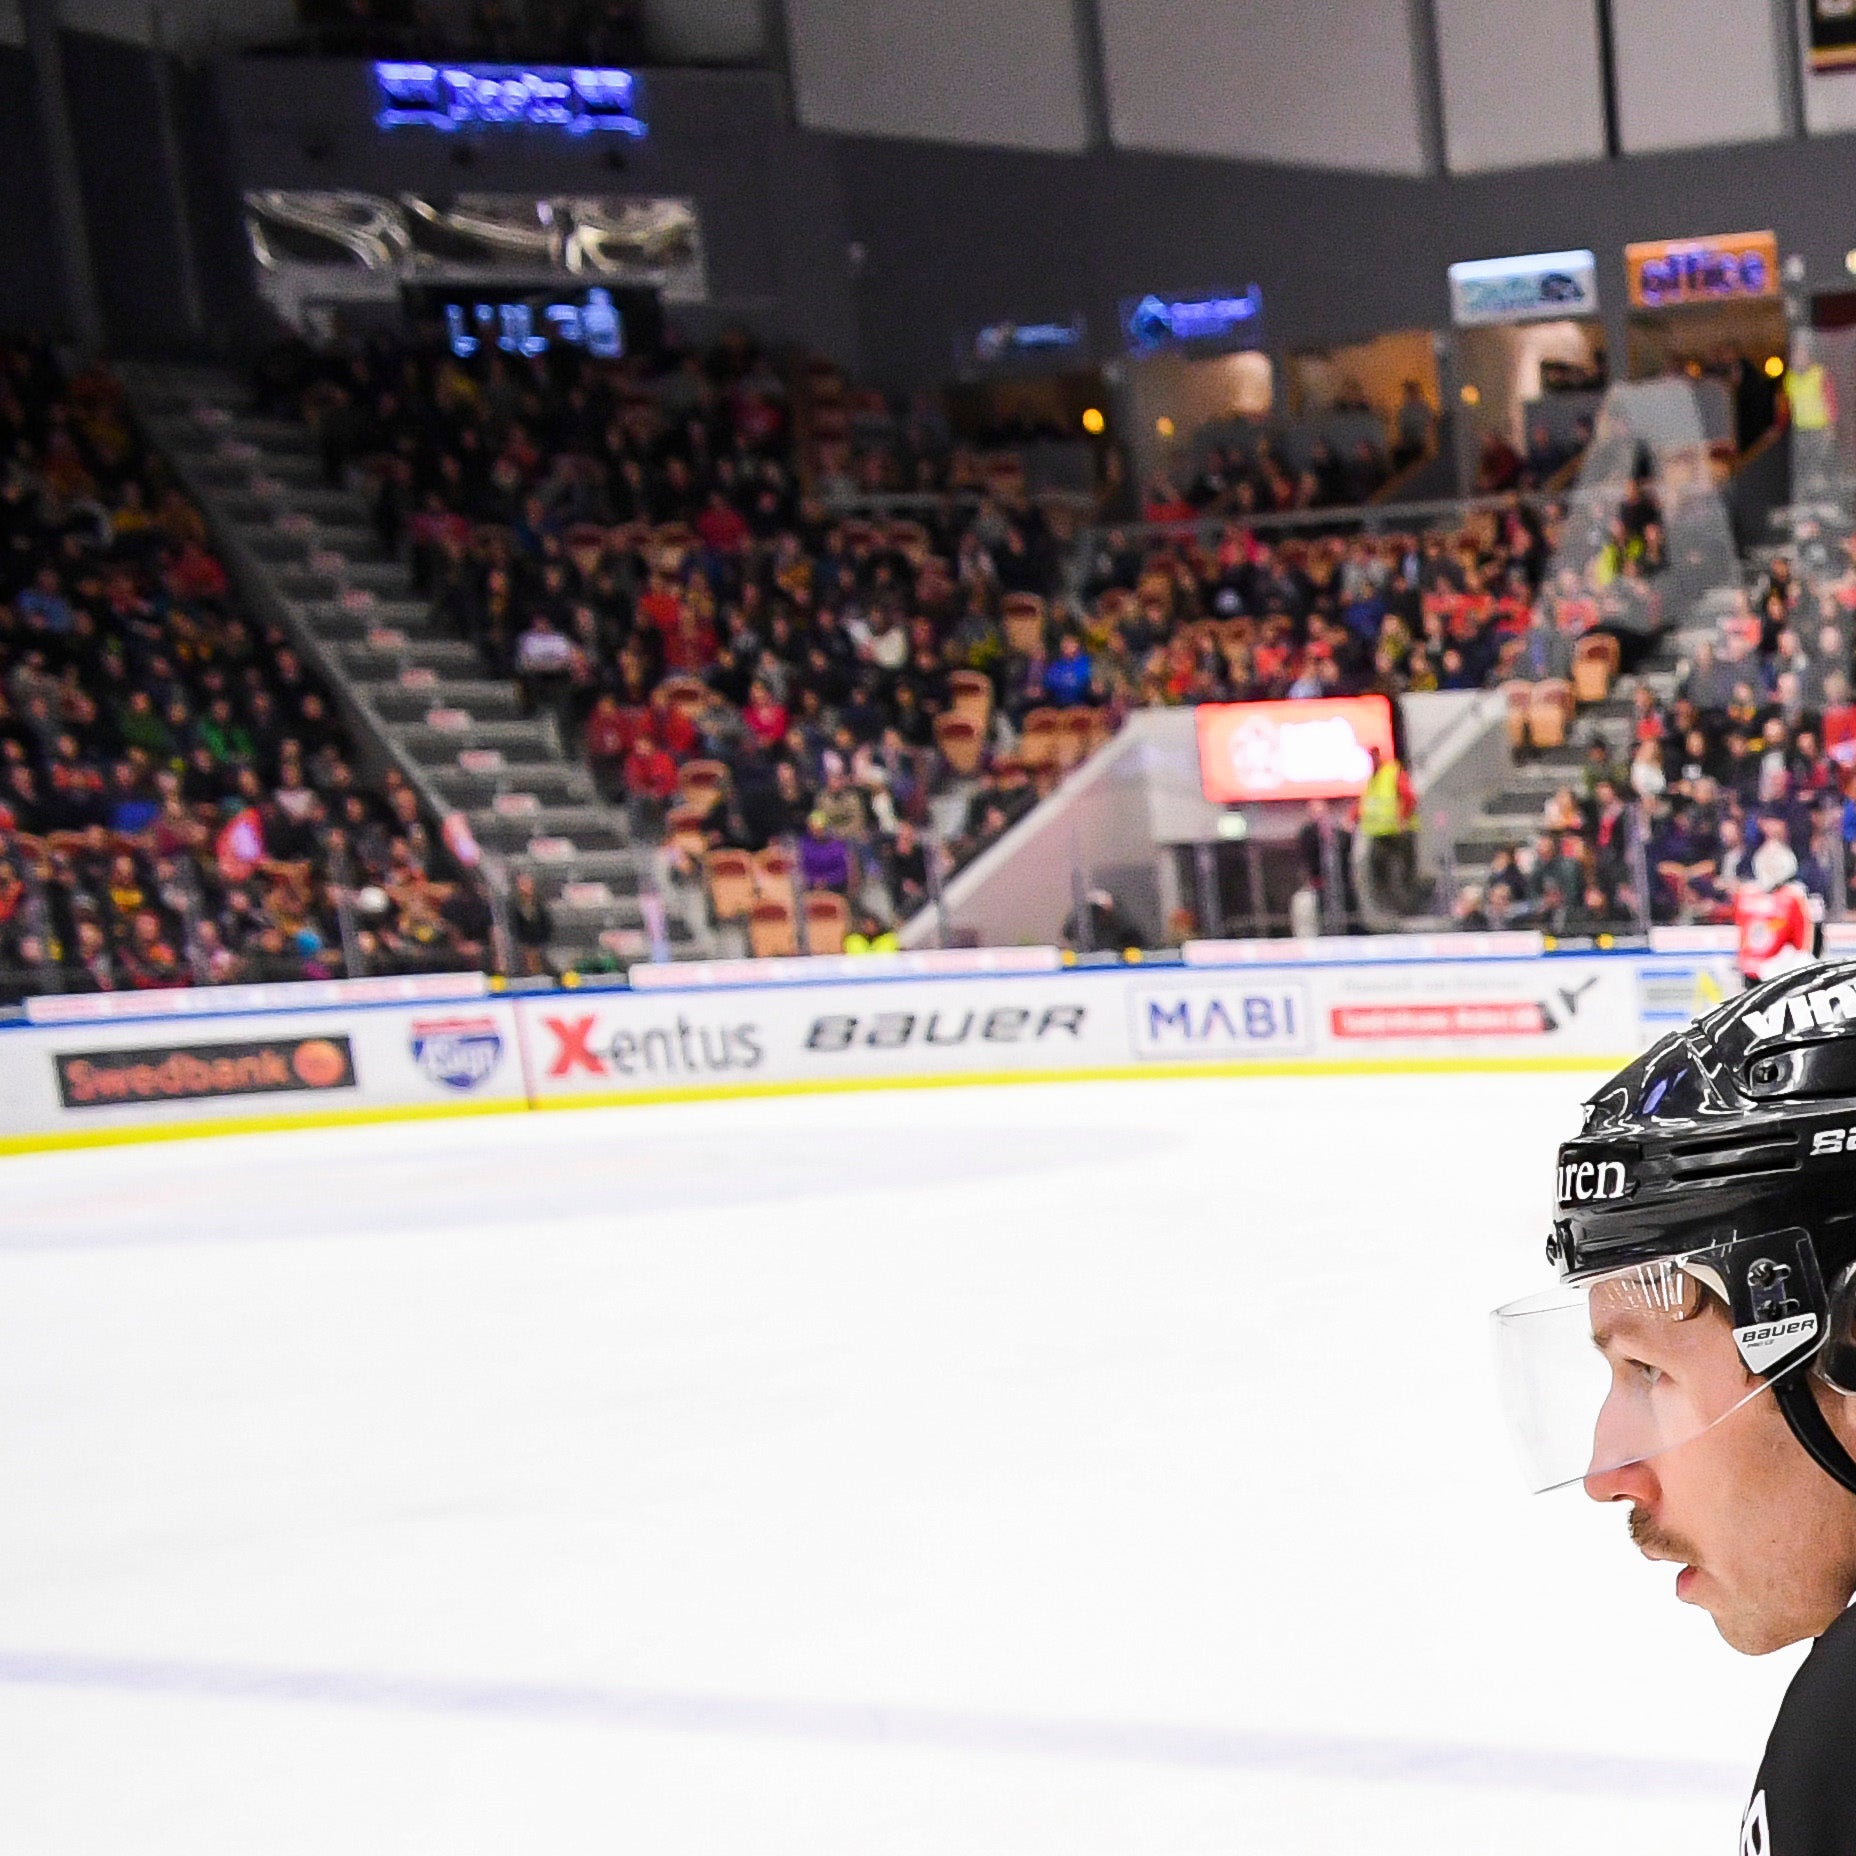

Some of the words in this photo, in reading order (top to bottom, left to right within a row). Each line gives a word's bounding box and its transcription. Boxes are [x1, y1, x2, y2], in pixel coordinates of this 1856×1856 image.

[806, 1004, 1088, 1052] BAUER
[1147, 997, 1297, 1041] MABI
[64, 1048, 290, 1100] Swedbank
[1742, 1318, 1816, 1344] BAUER
